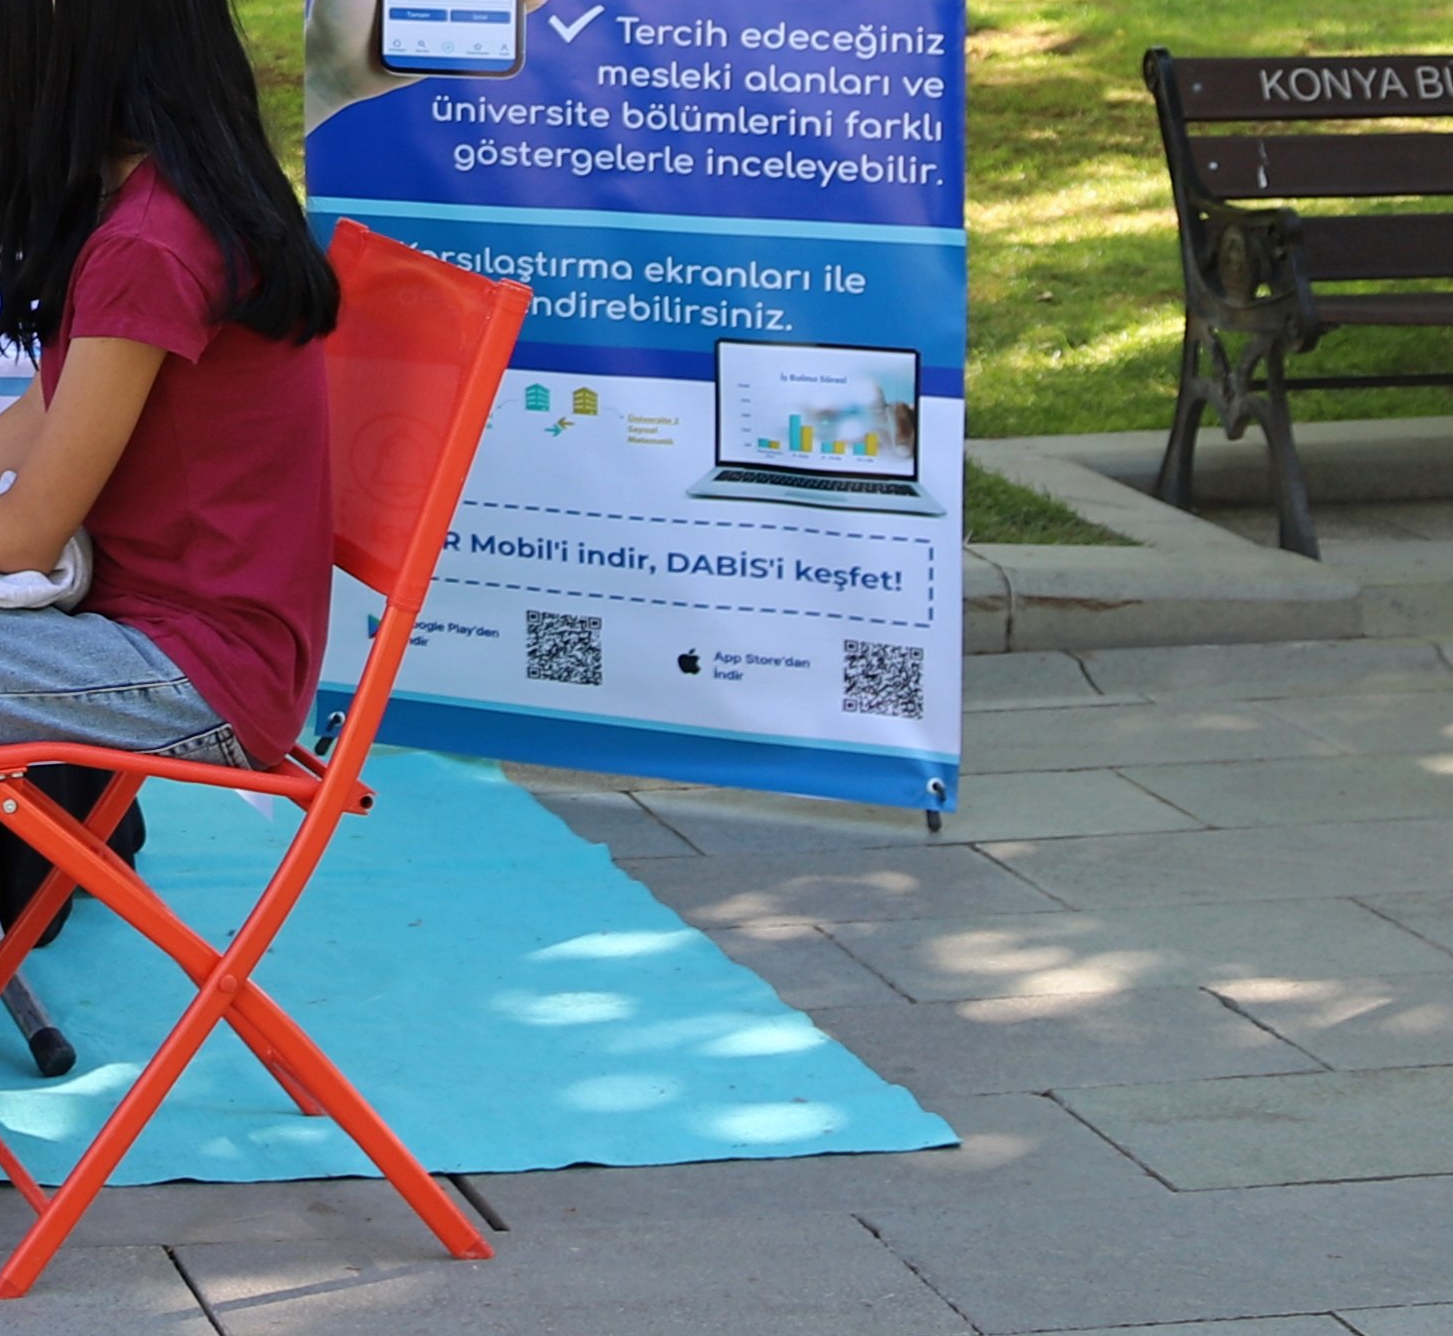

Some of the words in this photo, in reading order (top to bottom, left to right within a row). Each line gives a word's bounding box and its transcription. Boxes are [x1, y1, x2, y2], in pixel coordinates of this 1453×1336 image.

[616, 16, 727, 48] Tercih
[740, 18, 946, 60] edeceğiniz
[597, 60, 731, 90] mesleki
[744, 64, 890, 96] alanları
[902, 76, 944, 98] ve
[1259, 67, 1409, 102] KONYA
[1415, 65, 1453, 99] B
[432, 95, 610, 128] üniversite
[622, 101, 833, 137] bölümlerini
[844, 110, 945, 141] farklı
[453, 138, 694, 176] göstergelerle
[706, 147, 943, 188] inceleyebilir.
[644, 256, 810, 291] ekranları
[824, 264, 866, 294] ile
[470, 533, 568, 563] Mobil'i
[578, 541, 657, 575] indir,
[667, 551, 784, 580] DABİS'i
[795, 559, 902, 592] keşfet!
[713, 651, 743, 666] App
[713, 666, 744, 681] İndir
